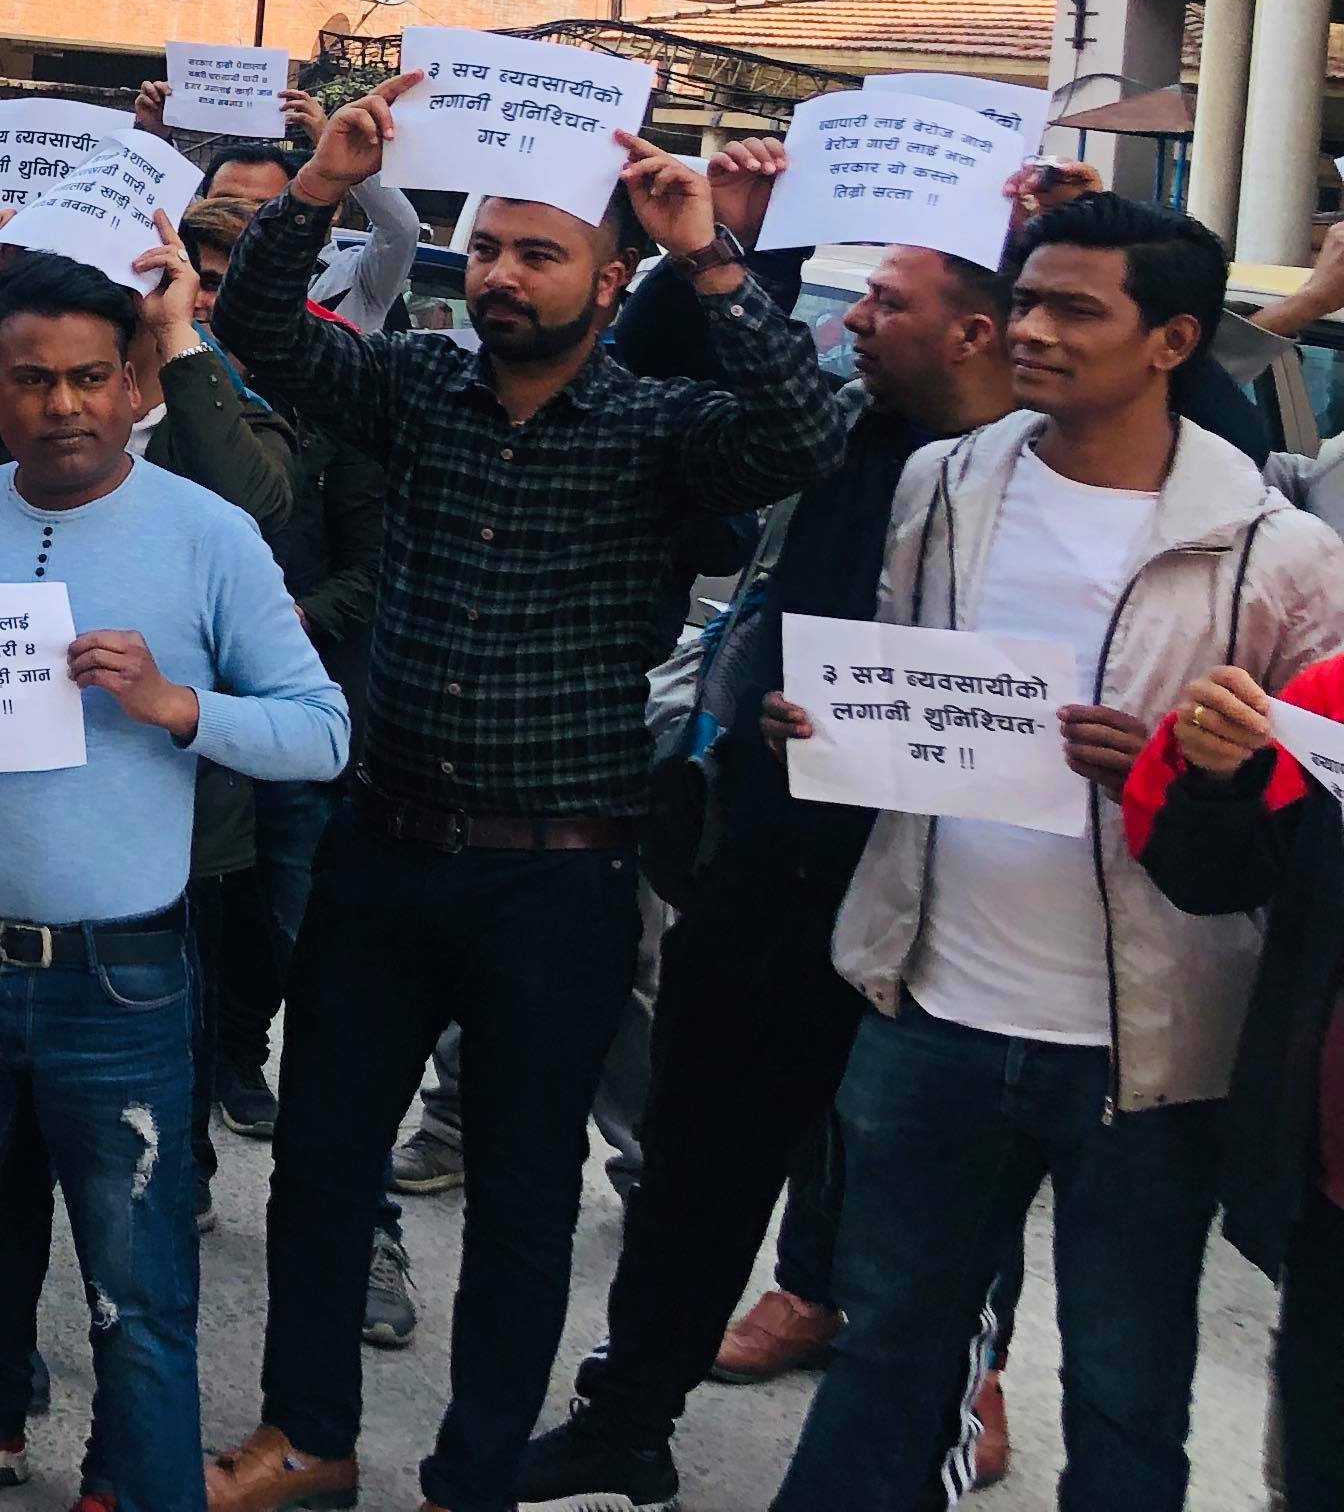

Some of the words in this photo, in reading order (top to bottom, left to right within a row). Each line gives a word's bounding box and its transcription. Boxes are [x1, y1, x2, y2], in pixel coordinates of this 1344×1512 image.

[428, 62, 439, 78] ३
[452, 63, 490, 80] सय
[429, 93, 492, 112] लगानी
[478, 128, 510, 148] गर
[2, 189, 28, 204] गर
[17, 668, 51, 684] जान
[822, 664, 838, 685] ३
[850, 666, 894, 685] सय
[831, 700, 911, 722] लगानी
[908, 742, 946, 764] गर
